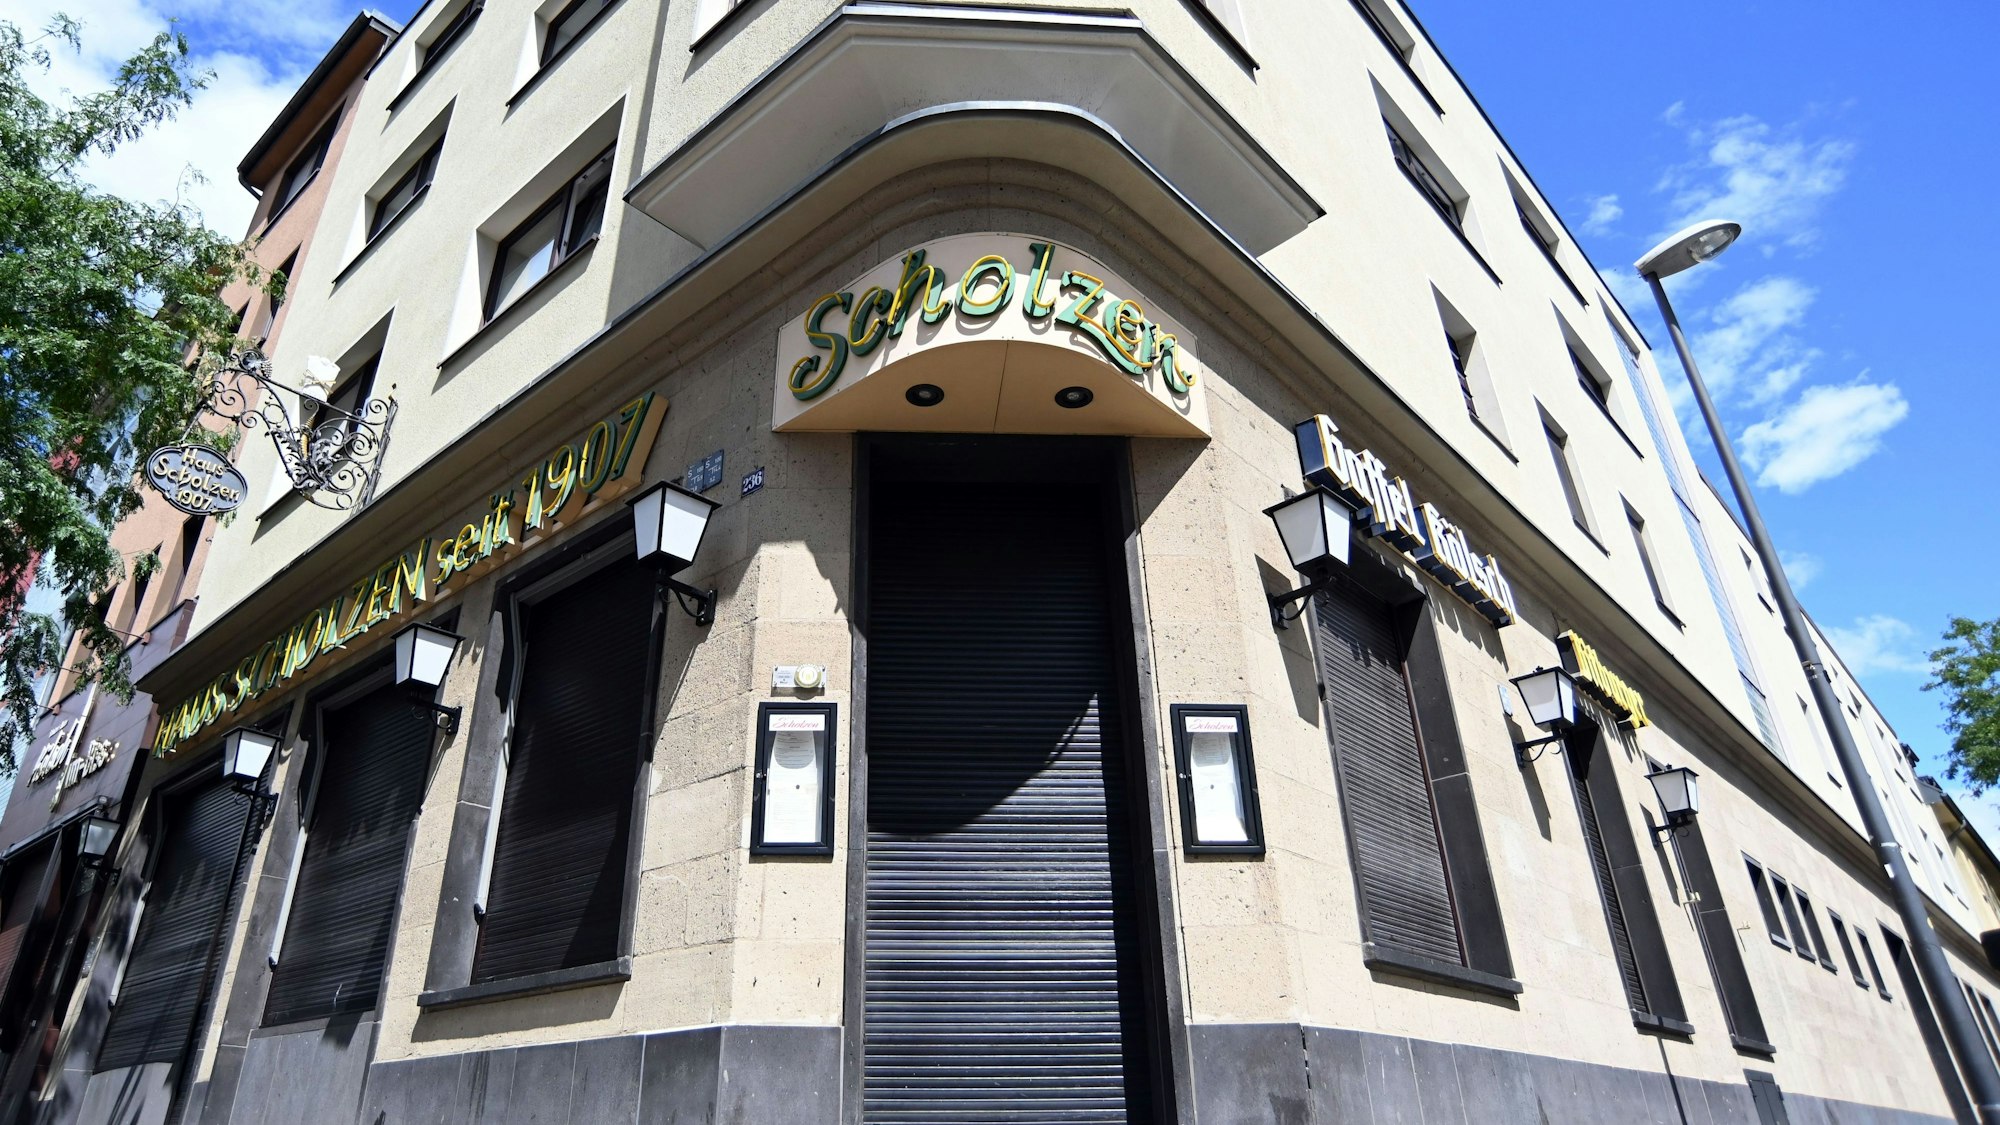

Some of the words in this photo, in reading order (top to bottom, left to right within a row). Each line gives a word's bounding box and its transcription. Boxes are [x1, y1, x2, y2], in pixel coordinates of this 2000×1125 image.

[788, 243, 1196, 401] Scholzen
[153, 456, 241, 503] Scholzen
[181, 447, 225, 477] Haus
[175, 488, 213, 511] 1907
[742, 470, 763, 493] 236
[1312, 413, 1426, 547] Gaffel
[1419, 502, 1517, 625] Kölsch
[152, 671, 229, 758] HAUS
[227, 537, 432, 712] SCHOLZEN
[432, 488, 515, 586] seit
[521, 391, 657, 529] 1907
[771, 716, 820, 729] Scholzen
